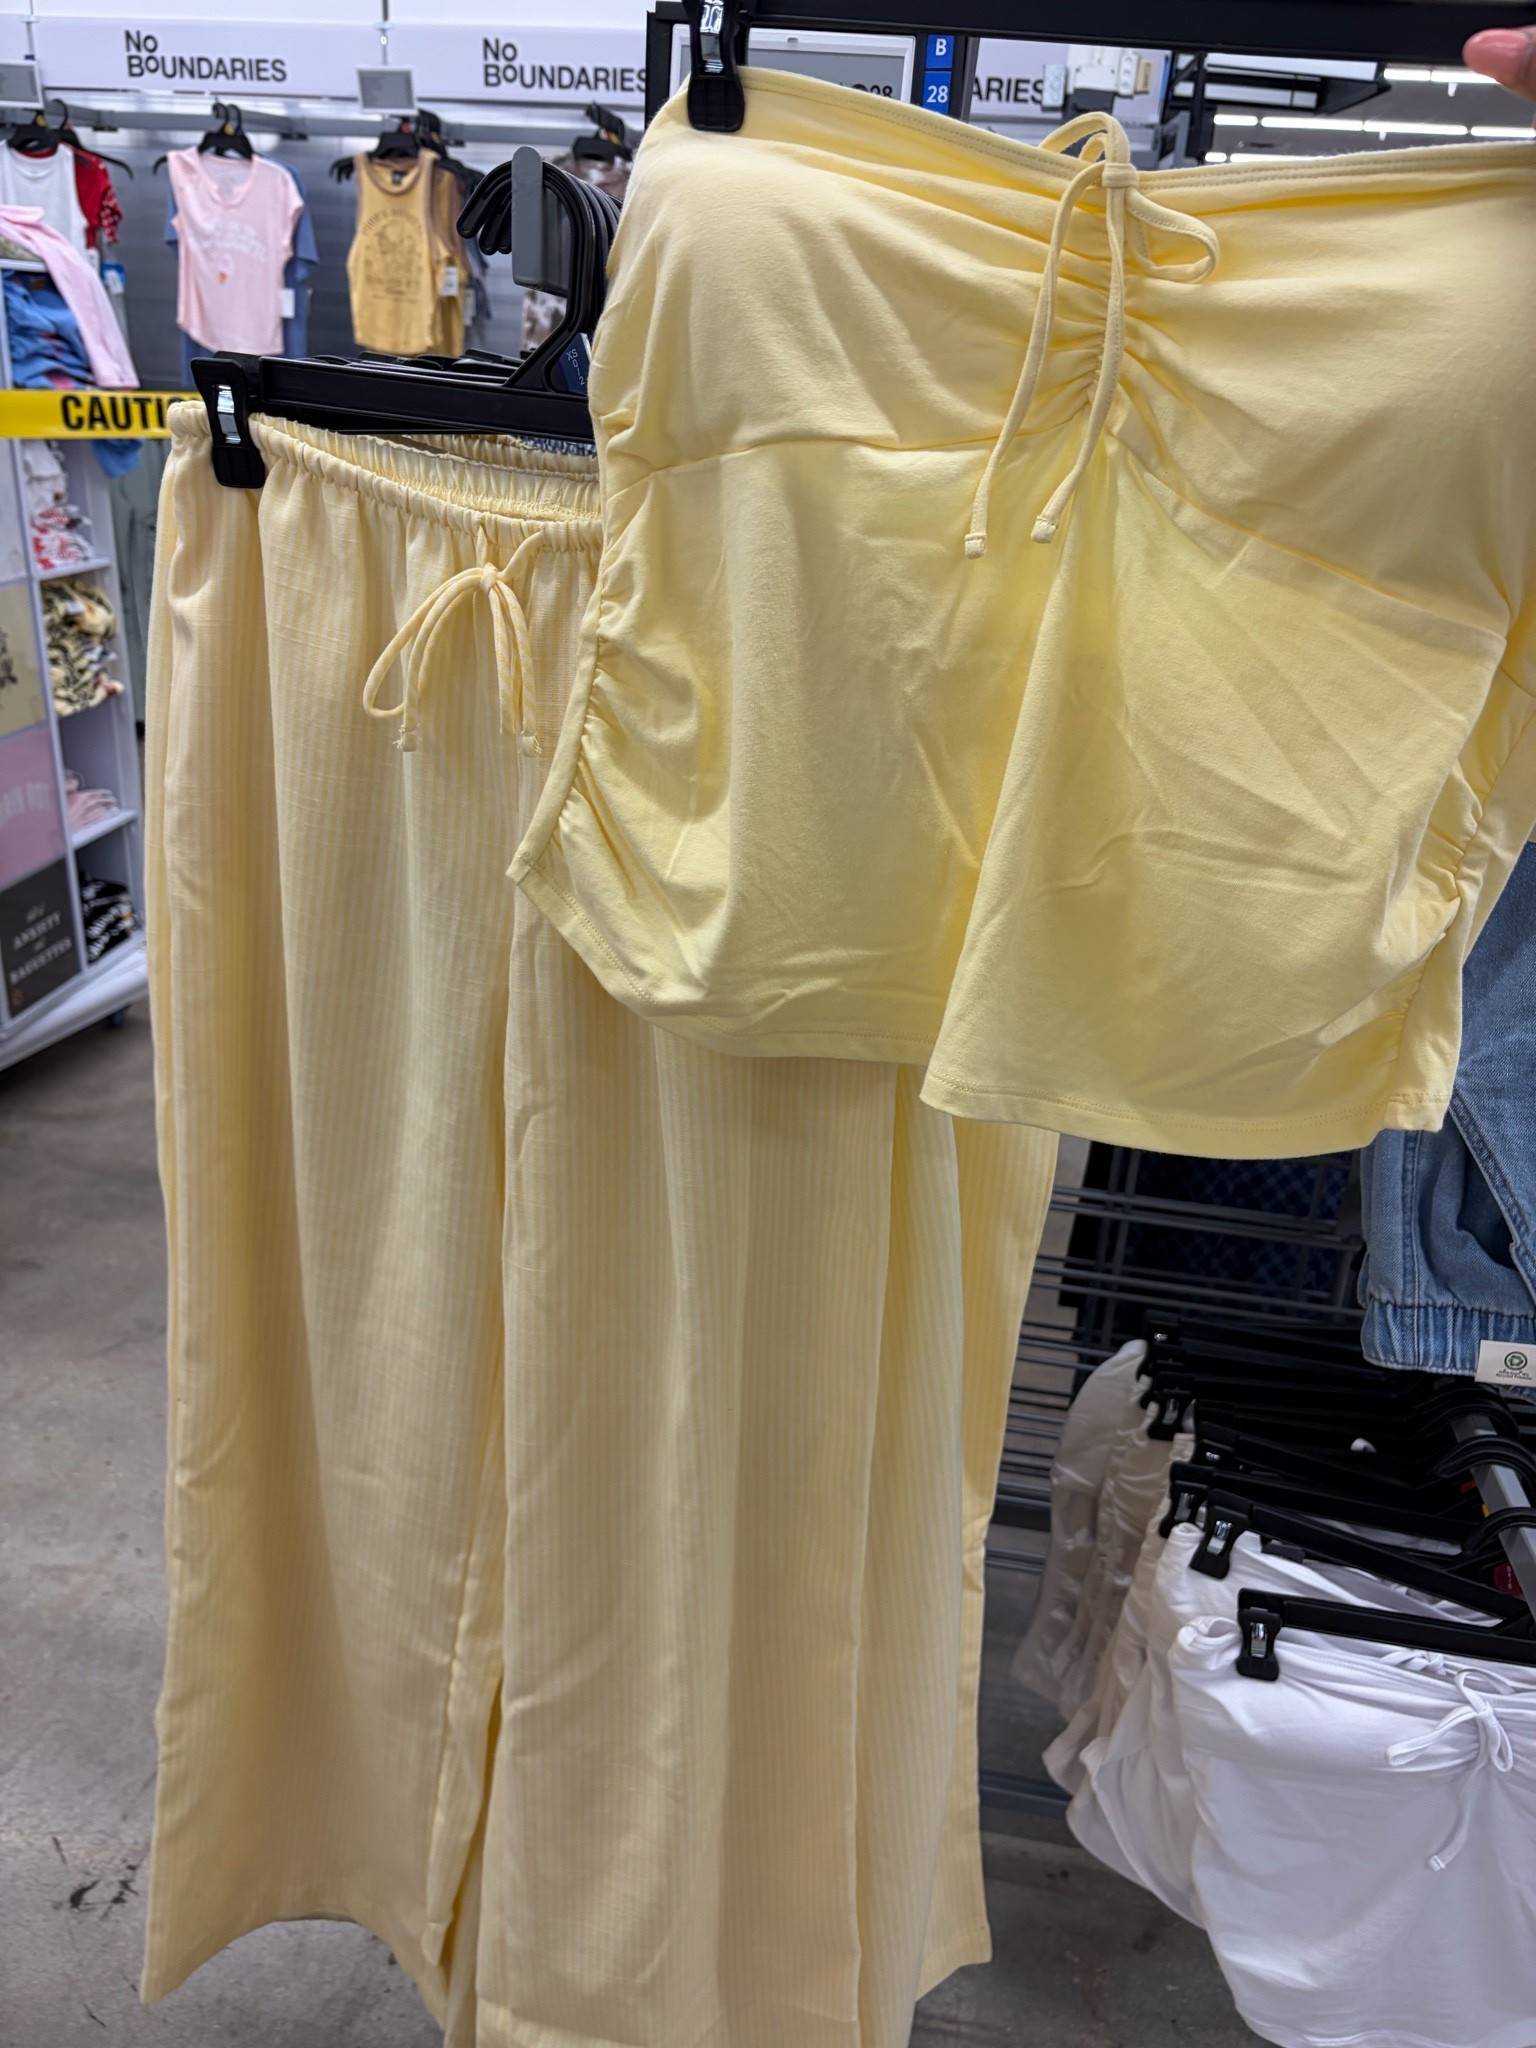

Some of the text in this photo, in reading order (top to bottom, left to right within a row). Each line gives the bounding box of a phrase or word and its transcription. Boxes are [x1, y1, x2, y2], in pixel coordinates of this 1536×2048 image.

[125, 30, 158, 53] No
[483, 38, 518, 62] No
[935, 38, 947, 56] B
[926, 85, 949, 103] 28
[566, 349, 579, 361] XS
[61, 395, 184, 431] CAUTI
